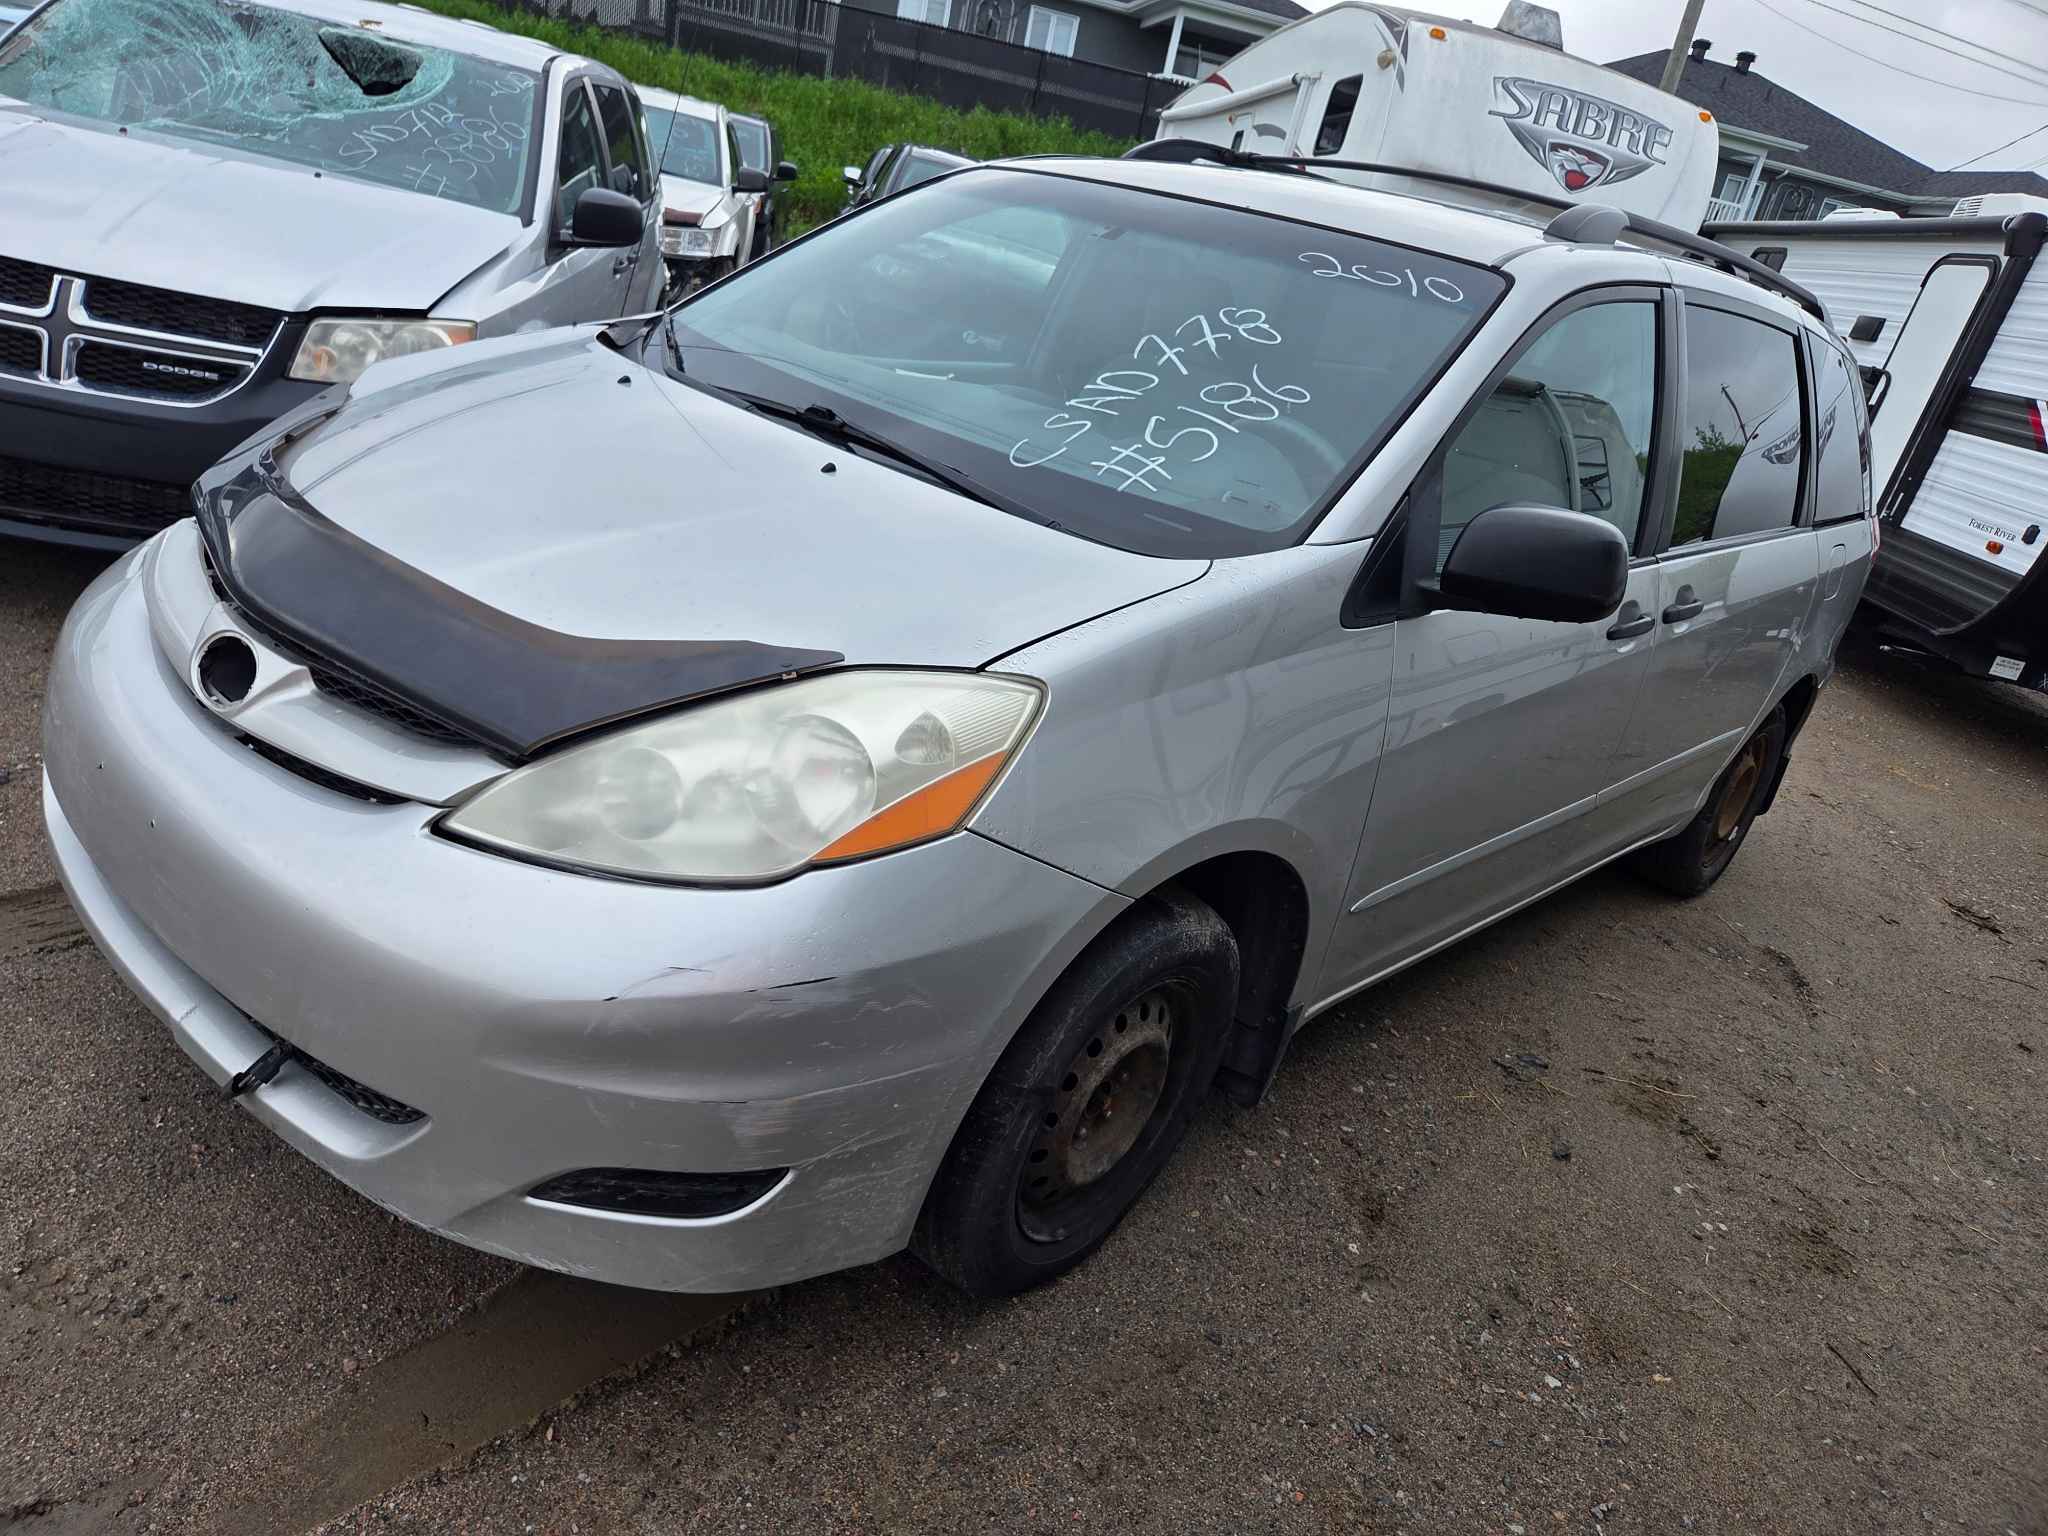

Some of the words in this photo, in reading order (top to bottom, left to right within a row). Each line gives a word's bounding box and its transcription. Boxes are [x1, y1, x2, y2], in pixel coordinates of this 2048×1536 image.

[1488, 76, 1674, 166] SABRE
[1299, 251, 1464, 303] 2010
[142, 361, 219, 380] DODGE
[1090, 363, 1312, 492] #5186
[1968, 518, 1995, 535] FOREST
[1993, 527, 2017, 542] RIVER
